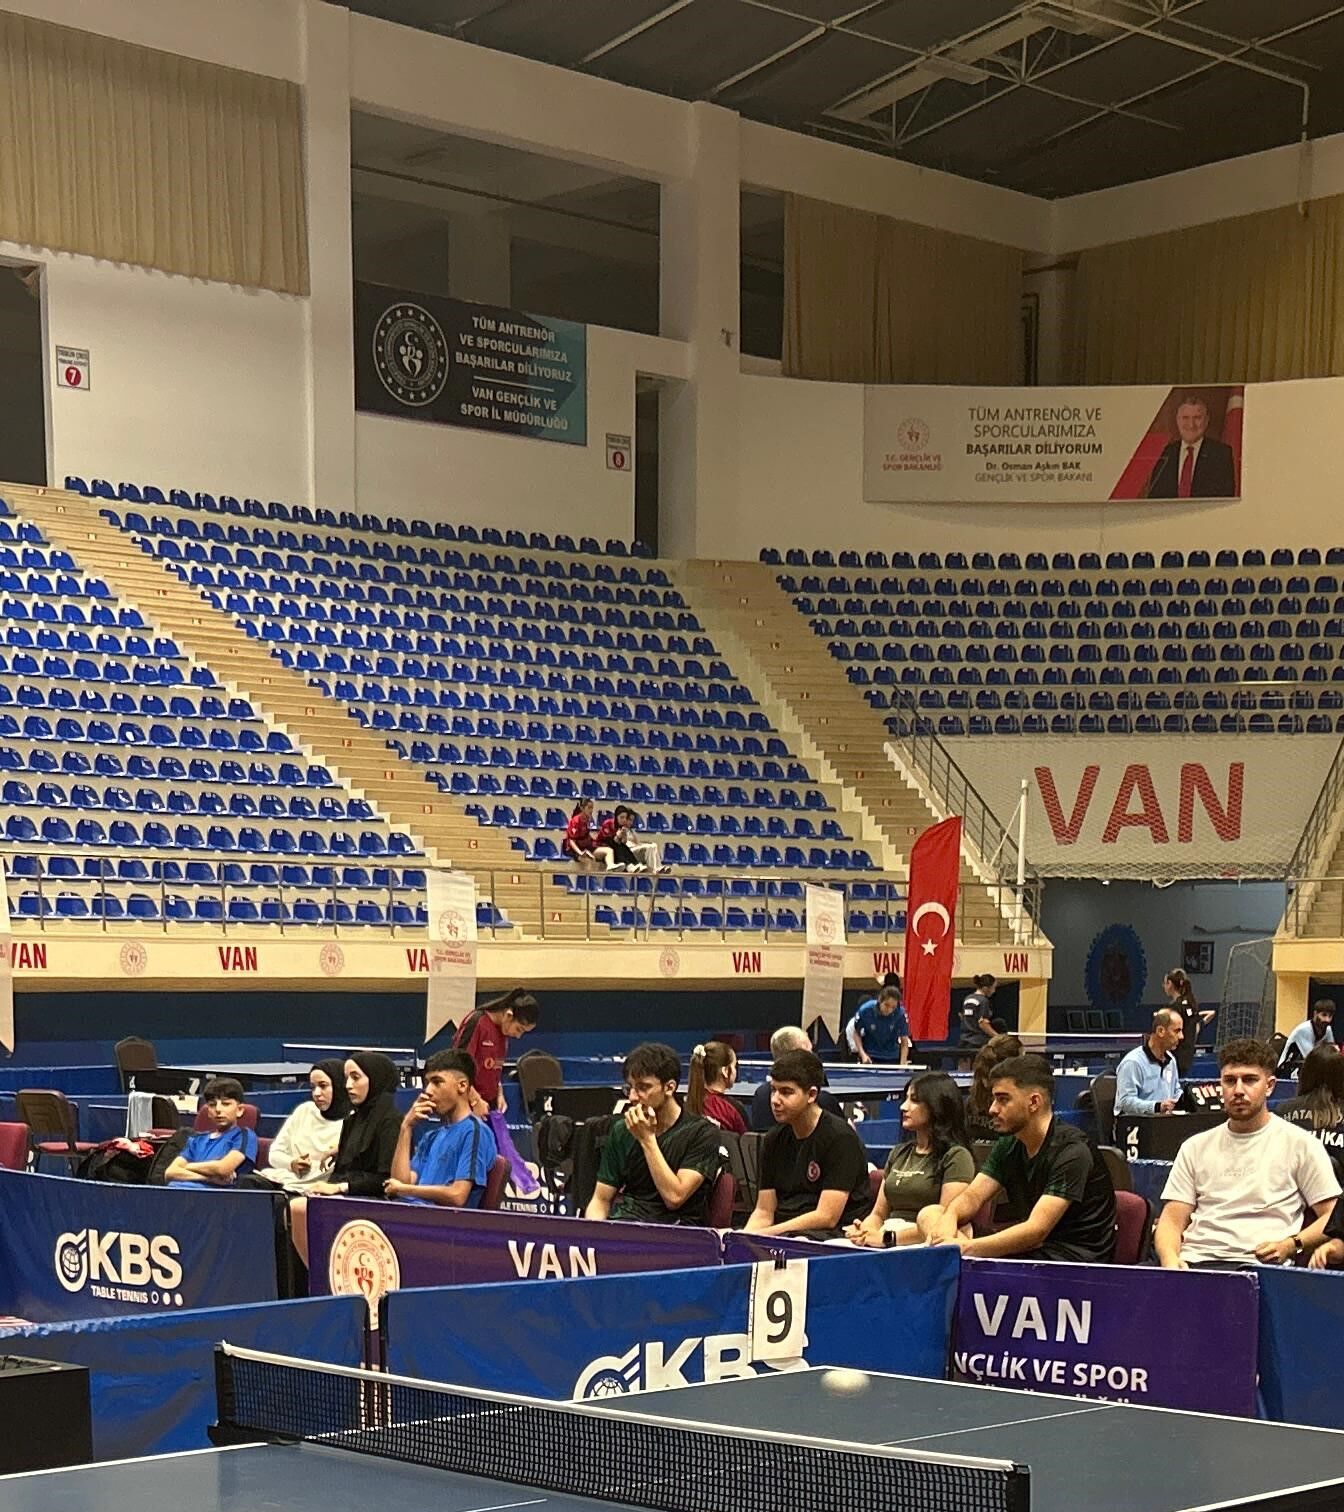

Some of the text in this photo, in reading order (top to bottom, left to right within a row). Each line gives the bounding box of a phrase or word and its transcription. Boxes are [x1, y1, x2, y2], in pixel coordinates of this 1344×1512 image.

[472, 316, 556, 343] TÜM ANTRENÖR
[459, 333, 568, 364] VE SPORCULARIMIZA
[70, 370, 76, 383] 7
[456, 351, 572, 382] BAŞARILAR DİLİYORUZ
[460, 403, 489, 419] SPOR
[472, 386, 557, 411] VAN GENÇLİK VE
[968, 405, 1102, 421] TÜM ANTRENÖR VE
[974, 424, 1096, 438] SPORCULARIMIZA
[966, 442, 1103, 457] BAŞARILAR DİLİYORUM
[1035, 762, 1245, 846] VAN
[219, 946, 258, 971] VAN
[407, 949, 432, 972] VA
[733, 952, 762, 973] VAN
[874, 953, 900, 974] VAN
[1004, 953, 1029, 973] VAN
[88, 1229, 183, 1290] KBS
[508, 1240, 597, 1280] VAN
[90, 1285, 149, 1304] TABLE TENNIS
[766, 1290, 793, 1344] 9
[974, 1293, 1092, 1344] VAN
[645, 1333, 809, 1389] KB
[955, 1351, 1148, 1393] NÇLİK VE SPOR
